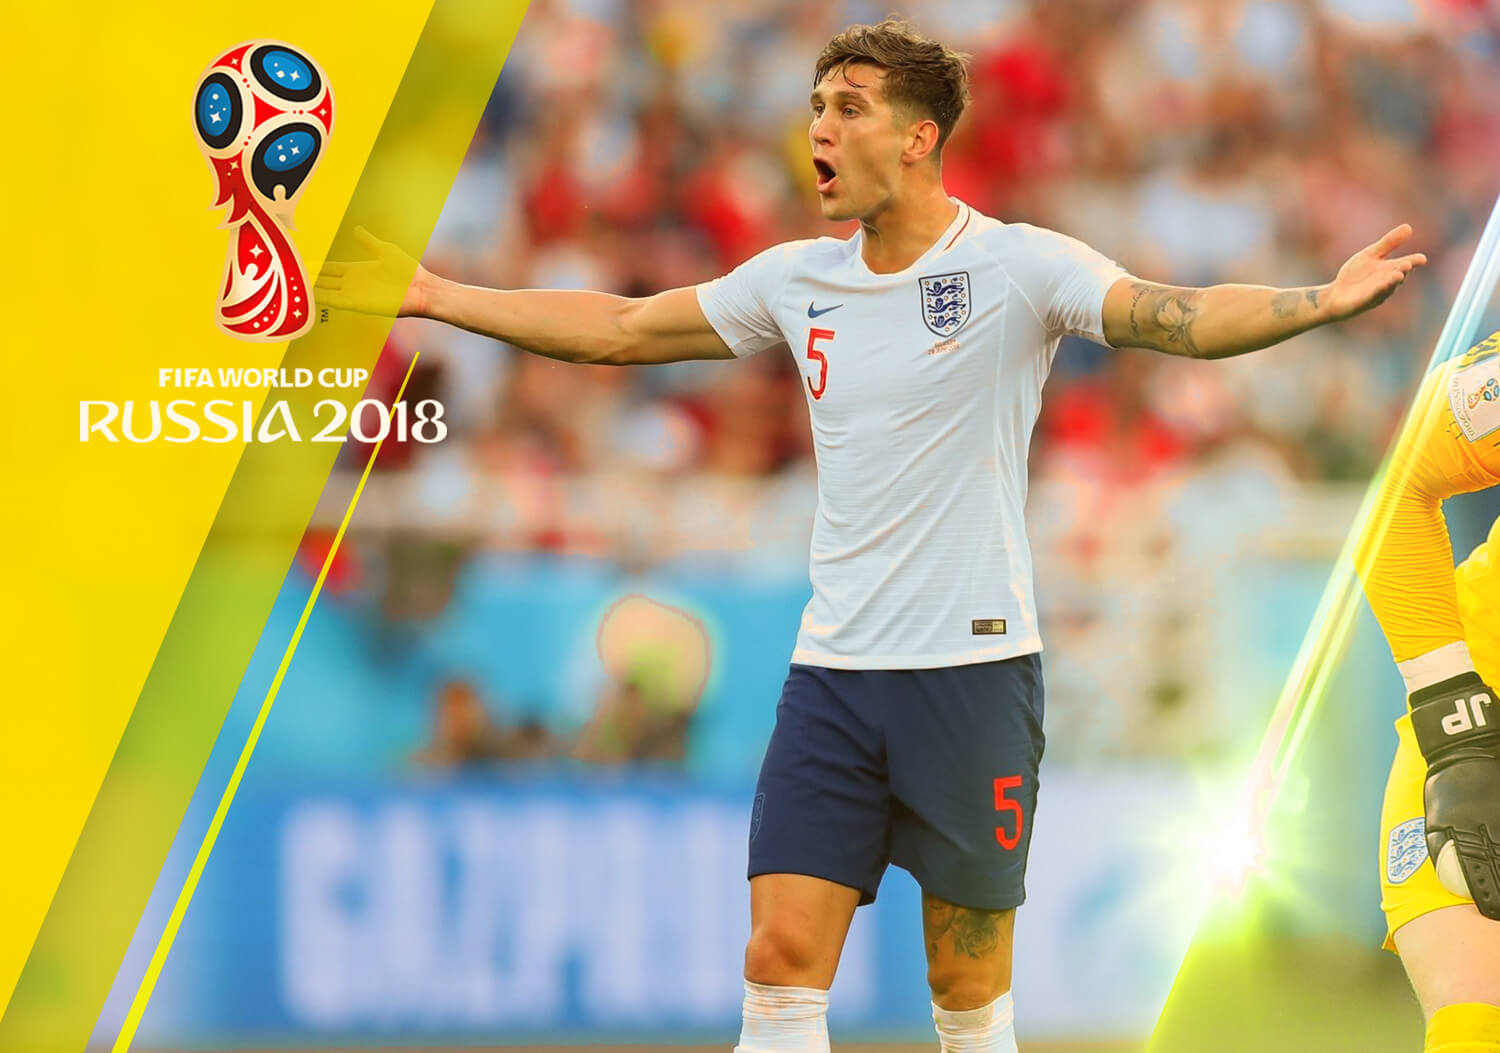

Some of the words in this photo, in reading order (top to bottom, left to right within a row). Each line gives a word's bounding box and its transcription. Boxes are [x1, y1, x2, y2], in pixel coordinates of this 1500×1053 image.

[806, 329, 836, 400] 5
[1441, 693, 1492, 735] JP
[992, 775, 1024, 851] 5
